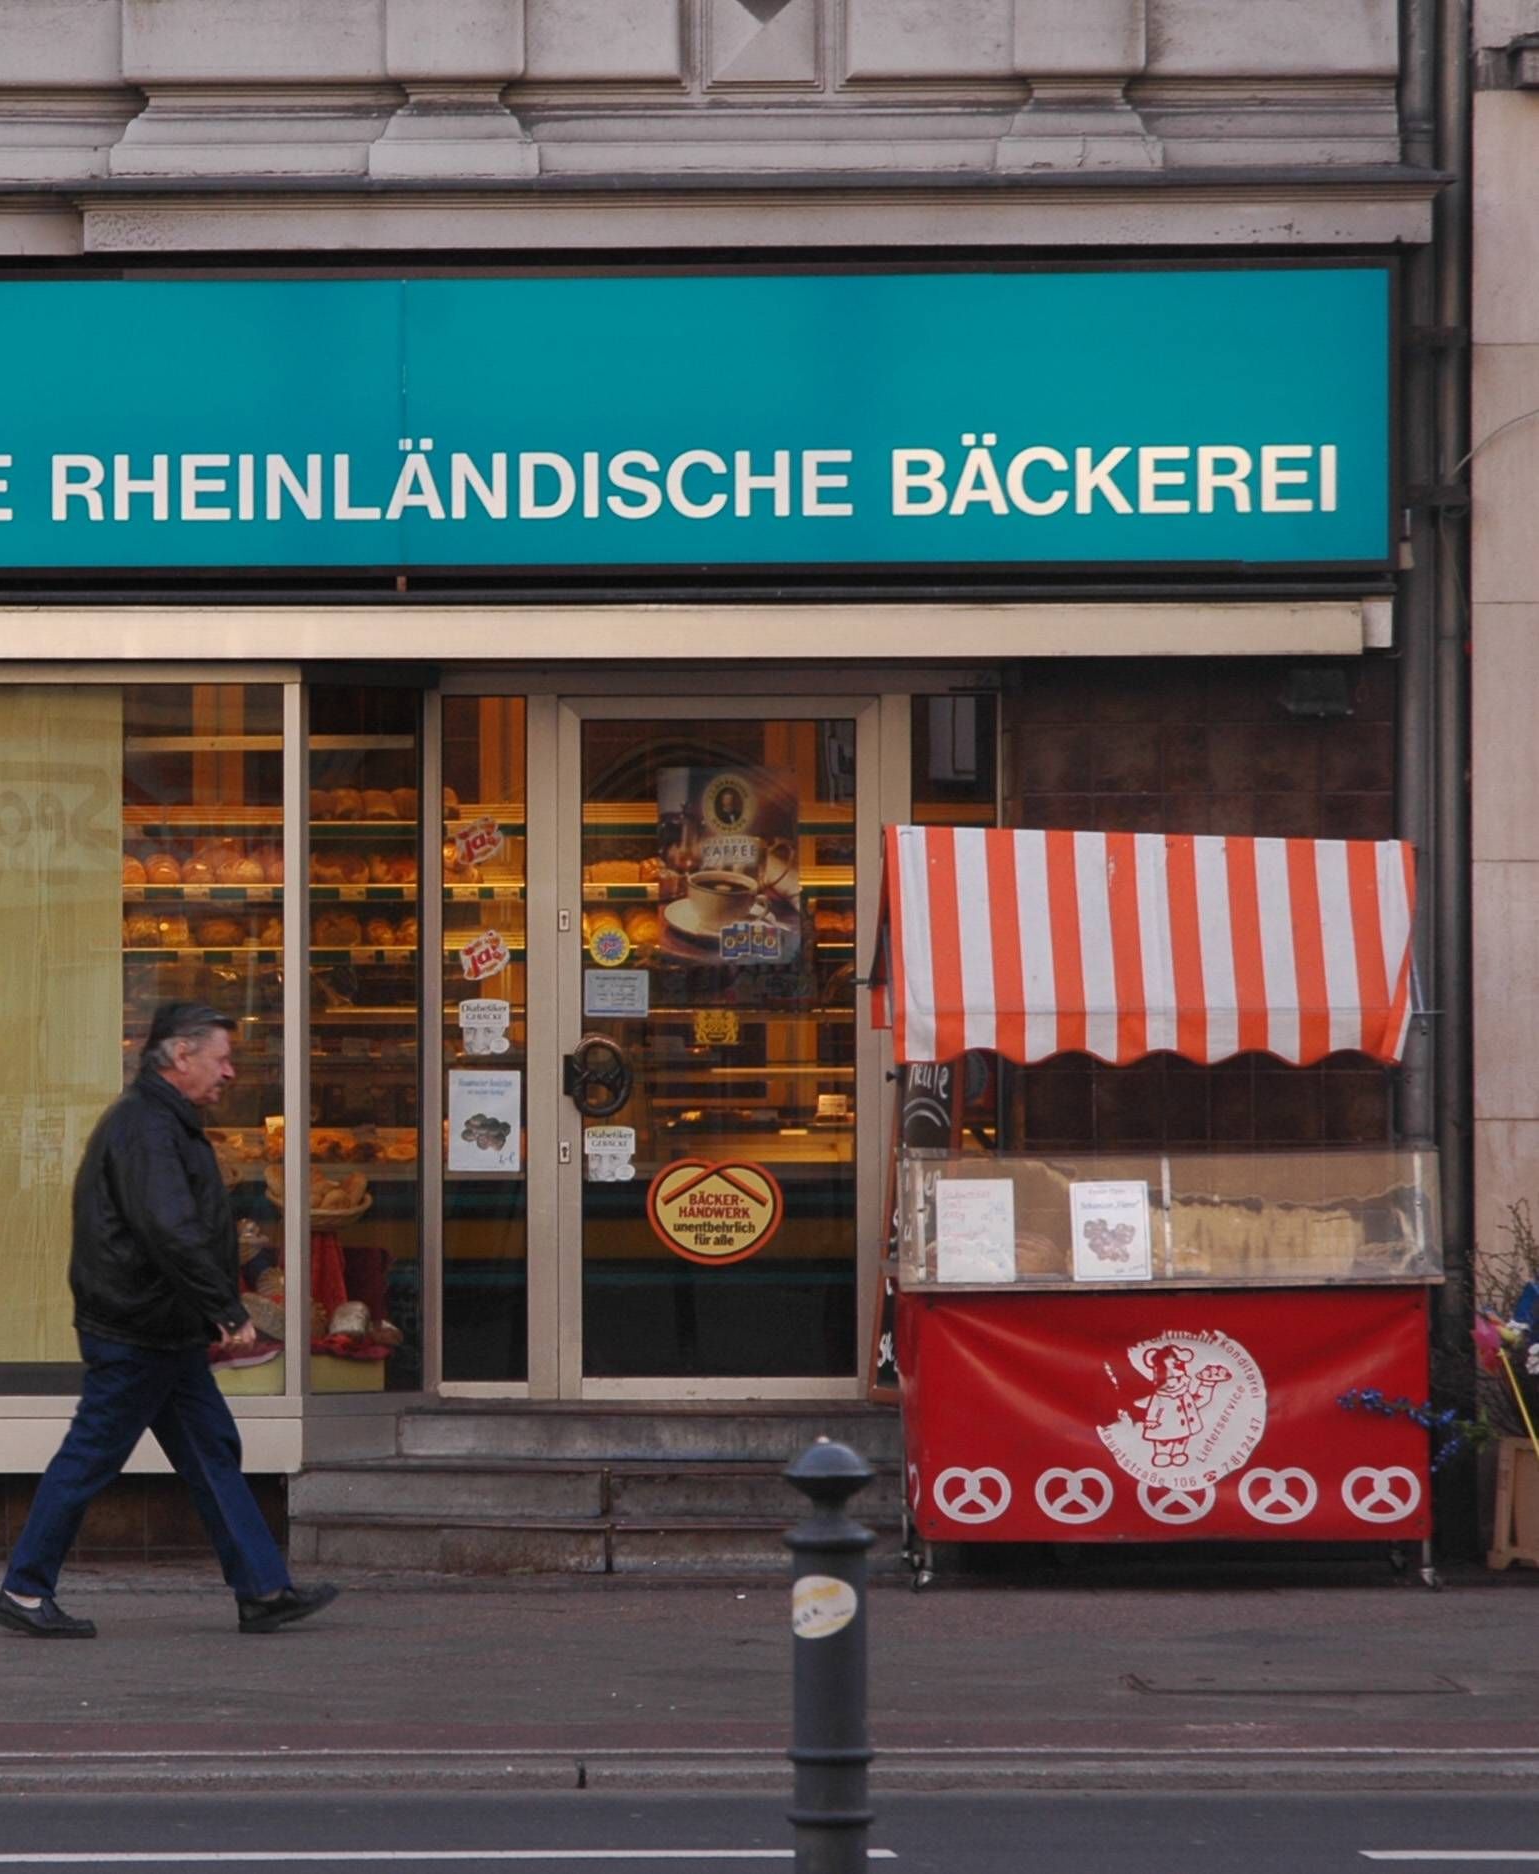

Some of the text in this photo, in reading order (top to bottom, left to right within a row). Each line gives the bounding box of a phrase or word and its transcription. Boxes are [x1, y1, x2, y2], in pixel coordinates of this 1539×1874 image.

[51, 436, 854, 521] RHEINLÄNDISCHE
[891, 432, 1337, 516] BÄCKEREI
[702, 844, 758, 857] KAFFEE
[689, 1190, 745, 1206] BÄCKER-
[678, 1206, 751, 1219] HANDWERK
[673, 1221, 756, 1234] unentbehrlich
[694, 1234, 735, 1246] für alle
[1219, 1338, 1262, 1399] Konditorei
[1173, 1476, 1198, 1488] 106
